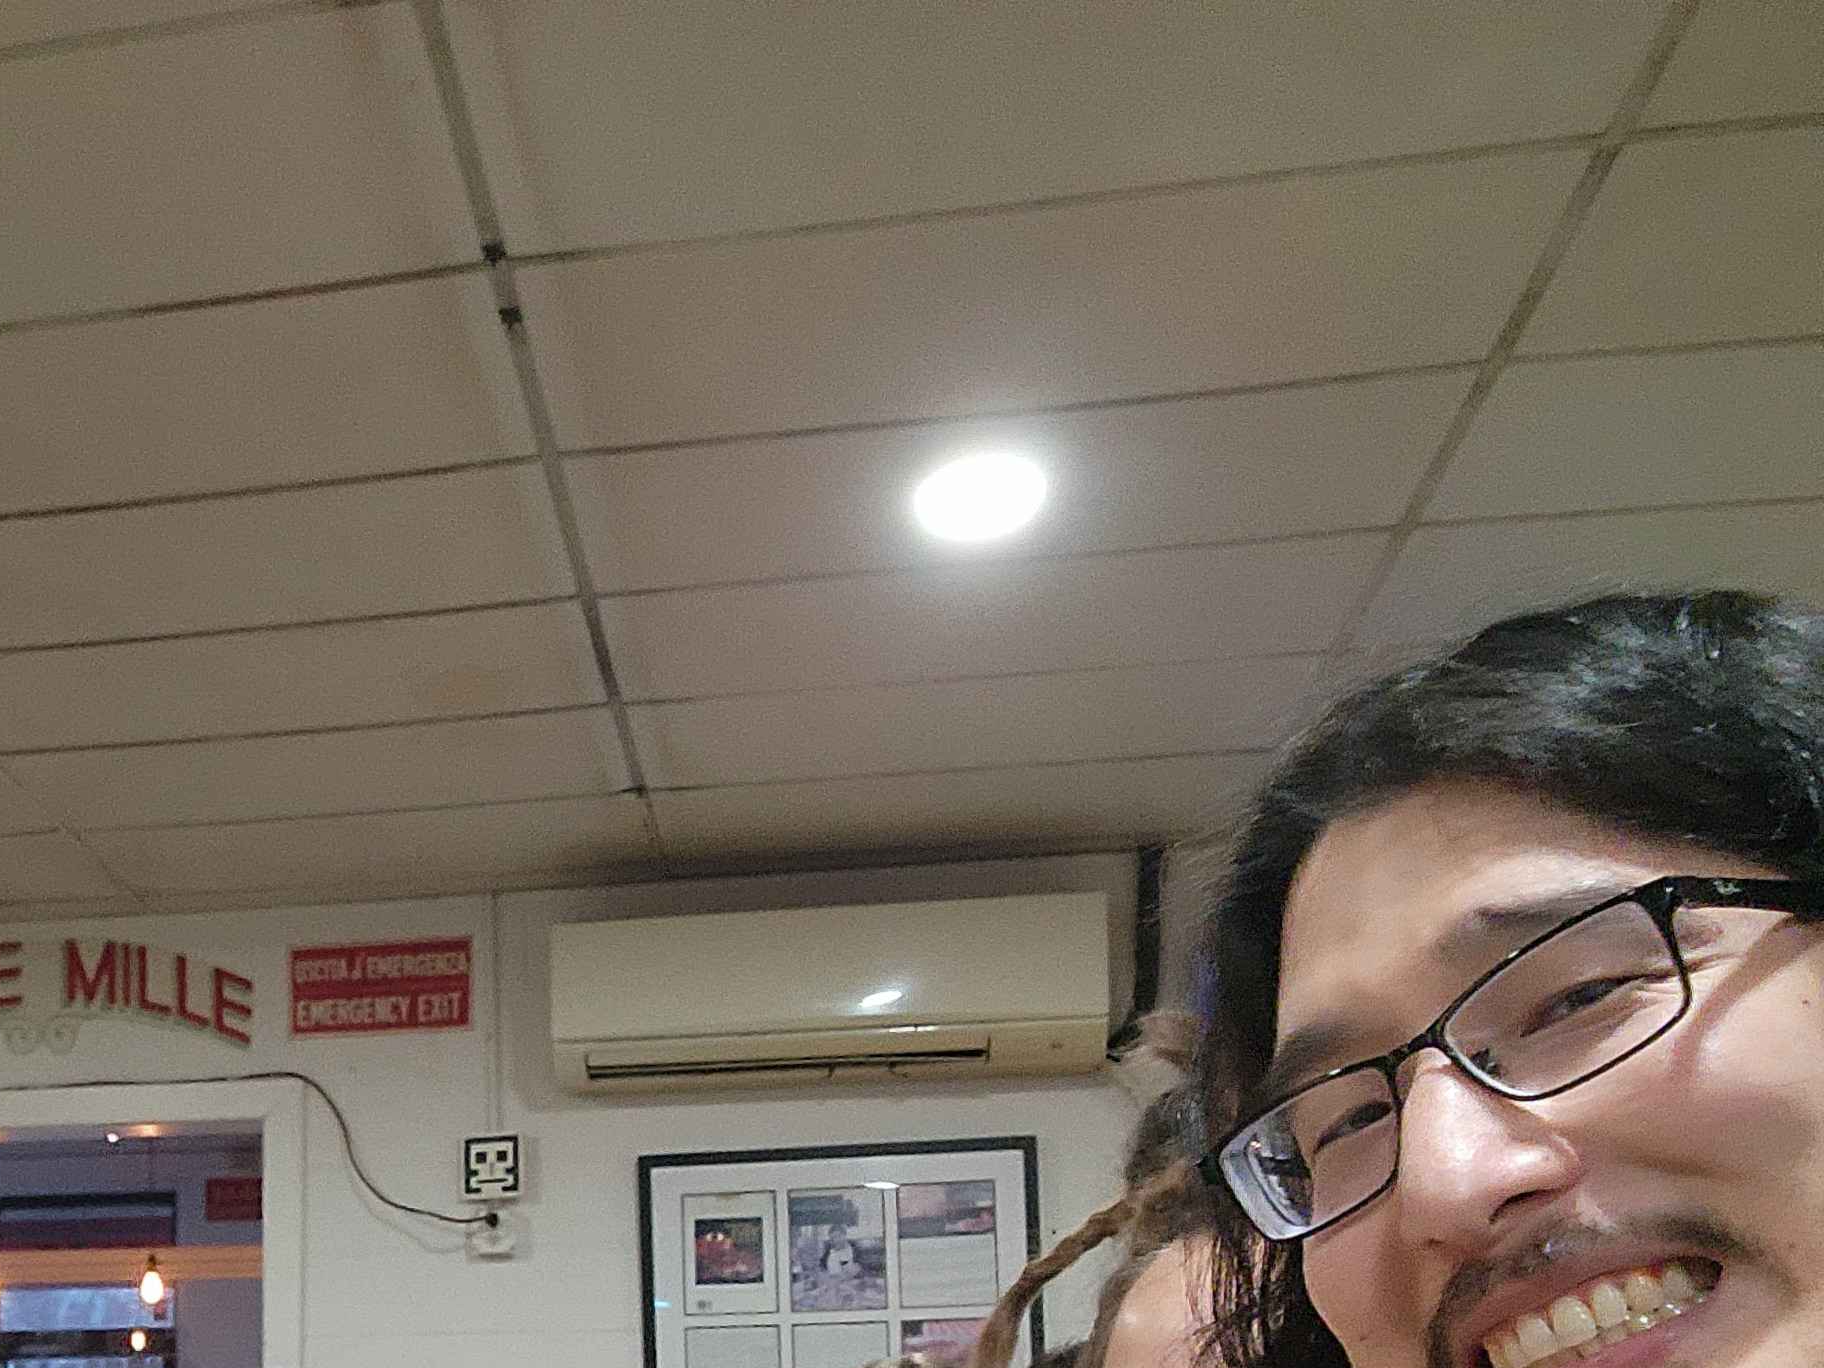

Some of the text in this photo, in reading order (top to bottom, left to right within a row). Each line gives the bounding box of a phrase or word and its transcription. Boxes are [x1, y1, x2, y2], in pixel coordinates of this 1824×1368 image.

[64, 938, 254, 1046] MILLE
[297, 992, 462, 1029] EMERGENCY EXIT
